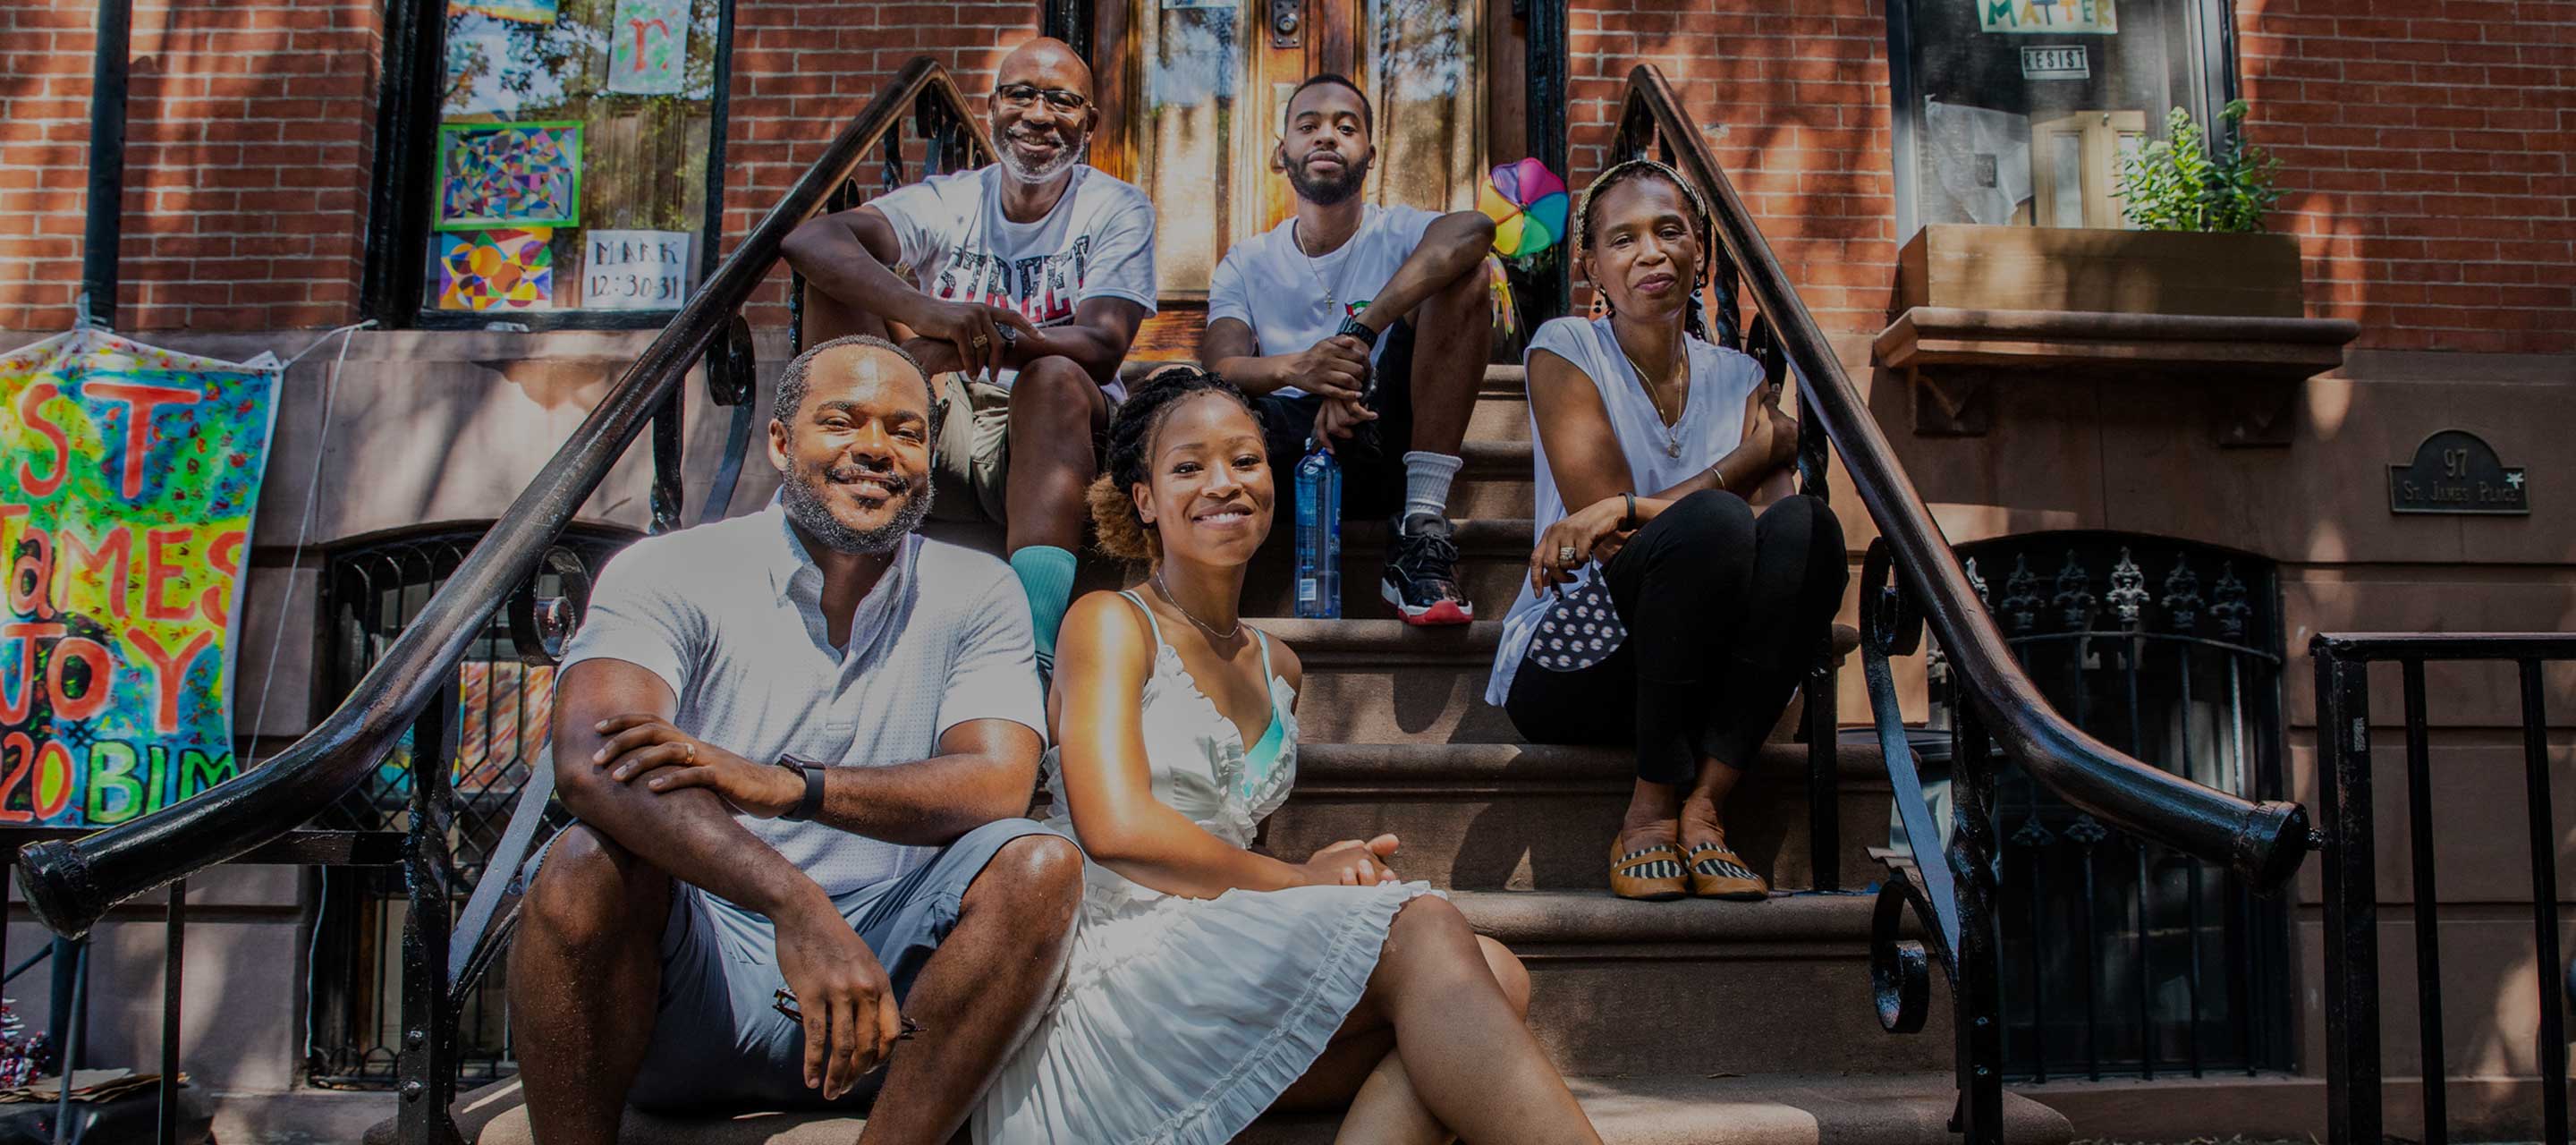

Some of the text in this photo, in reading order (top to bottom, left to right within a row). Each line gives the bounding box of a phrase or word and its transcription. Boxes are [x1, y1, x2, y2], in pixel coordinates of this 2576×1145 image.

[1987, 0, 2112, 27] MATTER
[2024, 51, 2084, 68] RESIST
[594, 241, 679, 266] MARK
[19, 381, 201, 499] ST
[2444, 449, 2469, 478] 97
[0, 623, 216, 734] JOY
